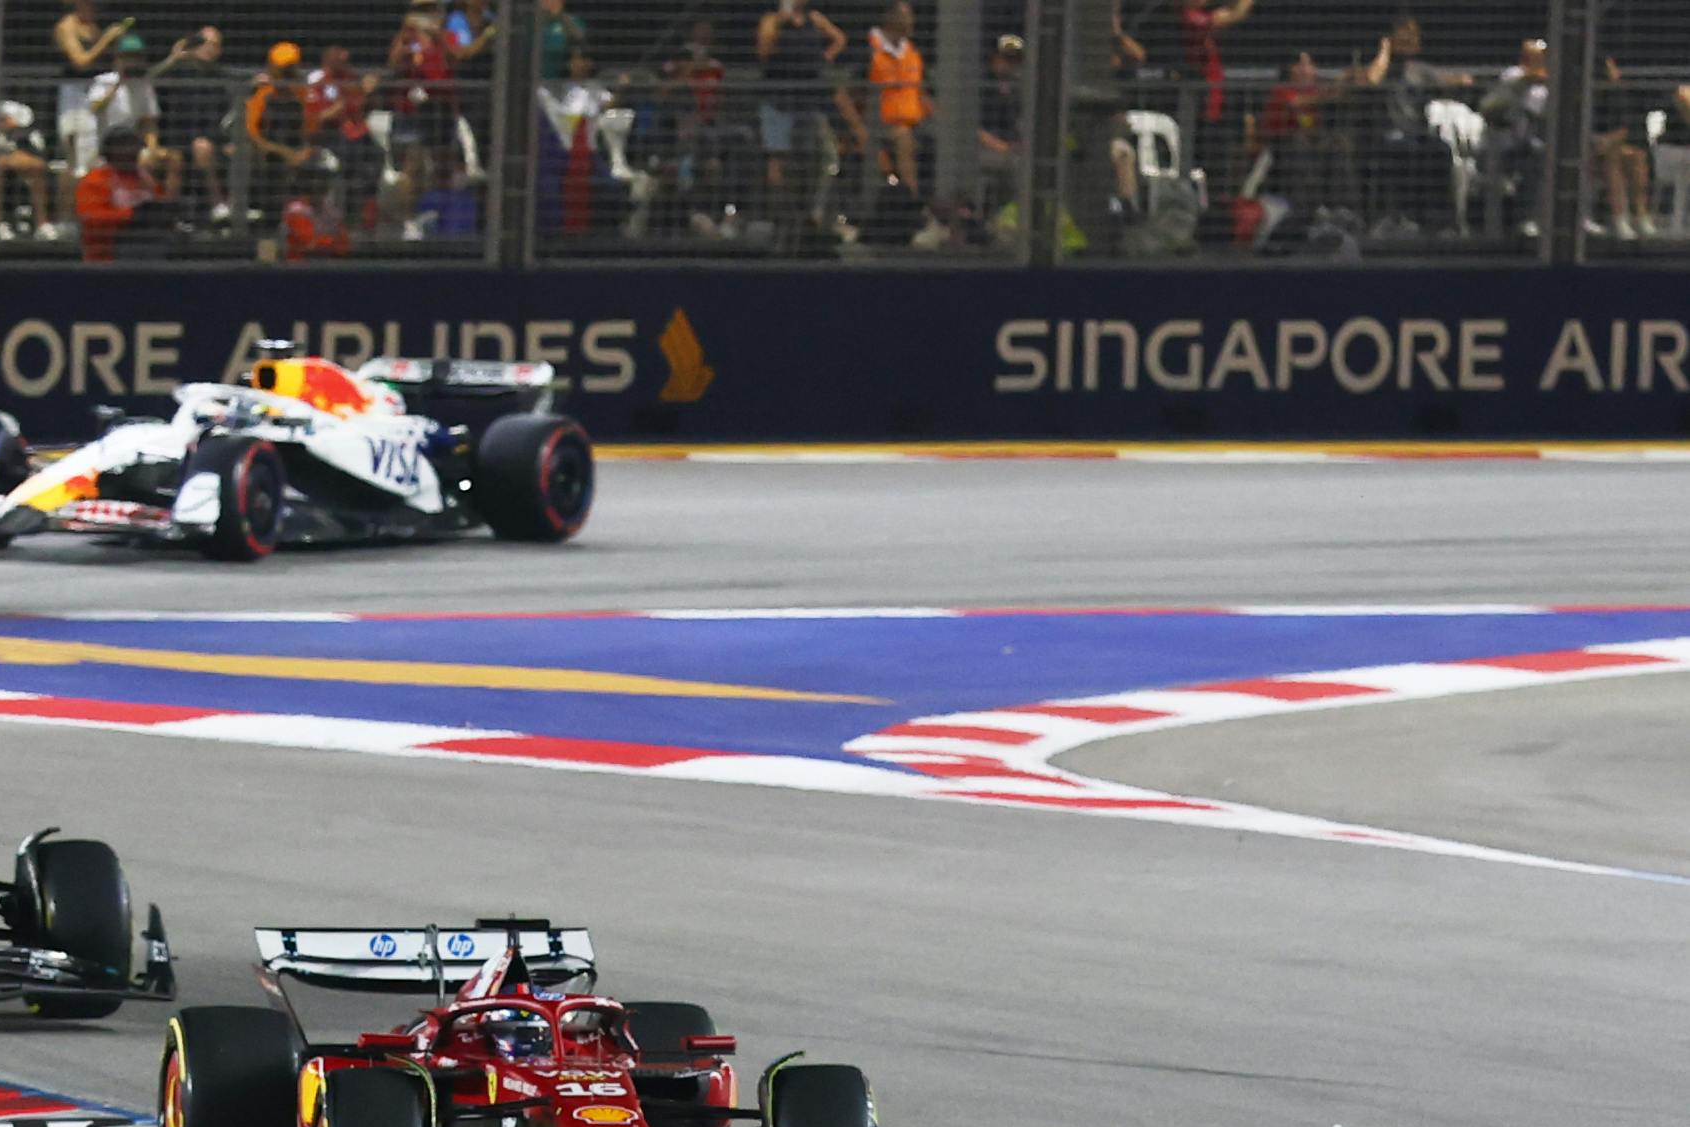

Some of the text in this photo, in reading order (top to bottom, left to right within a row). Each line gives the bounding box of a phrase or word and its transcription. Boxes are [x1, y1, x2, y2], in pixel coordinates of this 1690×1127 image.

[994, 317, 1690, 392] SINGAPORE AIR
[371, 934, 396, 957] hp
[448, 934, 475, 958] hp
[555, 1082, 627, 1097] 16
